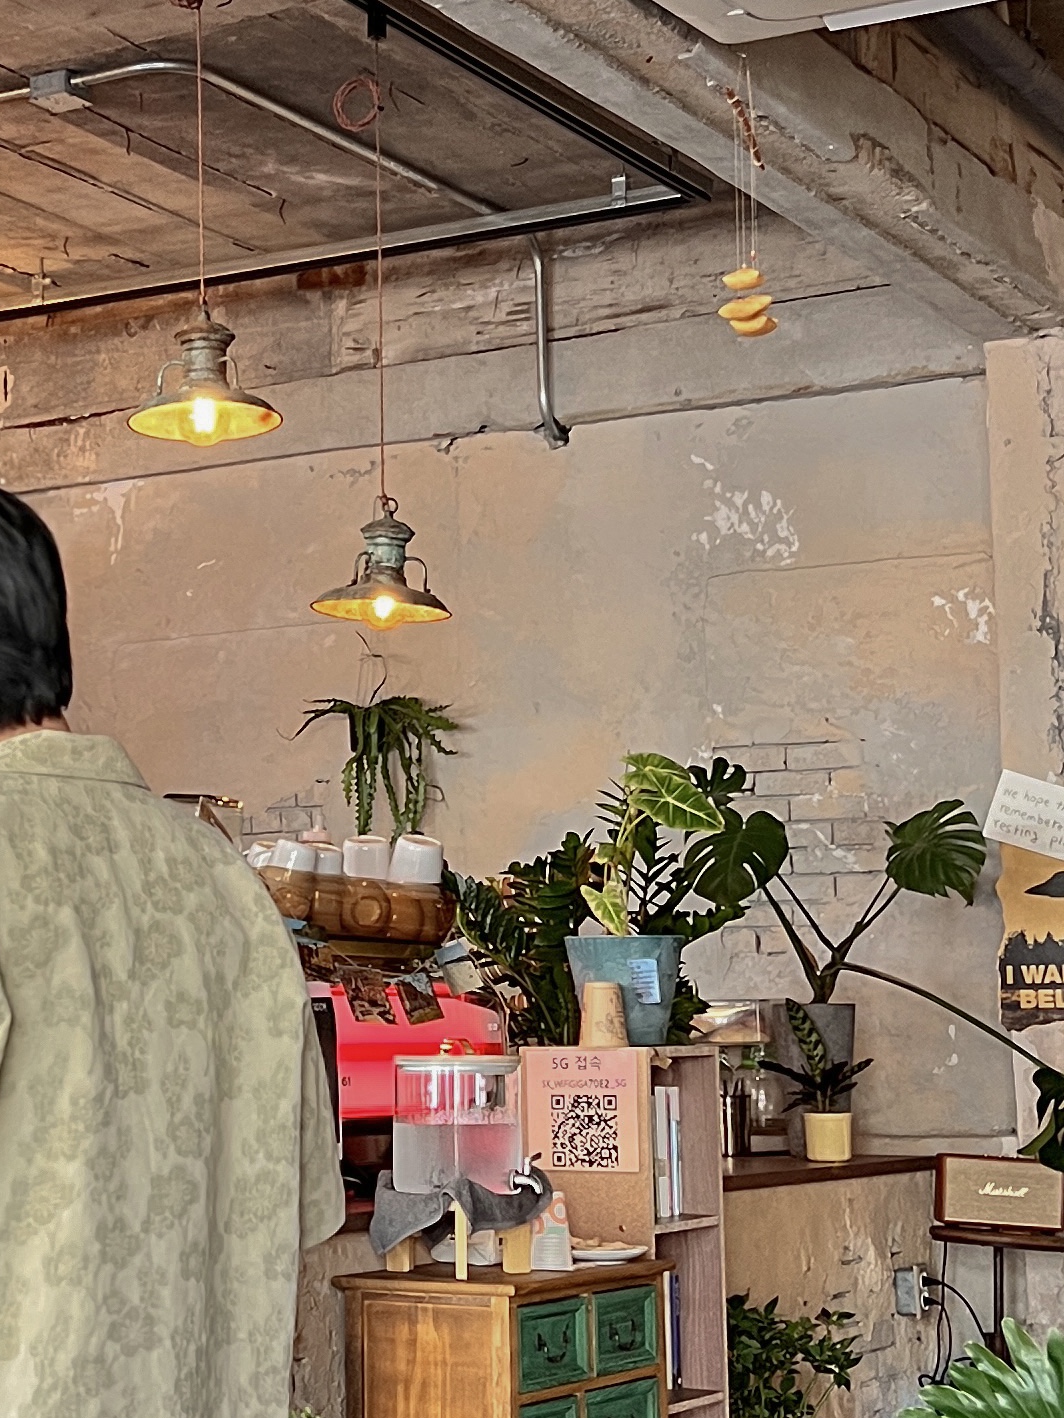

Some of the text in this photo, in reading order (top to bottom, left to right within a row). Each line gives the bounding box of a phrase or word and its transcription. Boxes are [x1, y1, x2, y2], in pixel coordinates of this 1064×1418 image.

[1023, 790, 1050, 807] hope
[993, 819, 1038, 844] resting
[1006, 964, 1064, 985] I WA
[552, 1055, 602, 1071] 5G 접속
